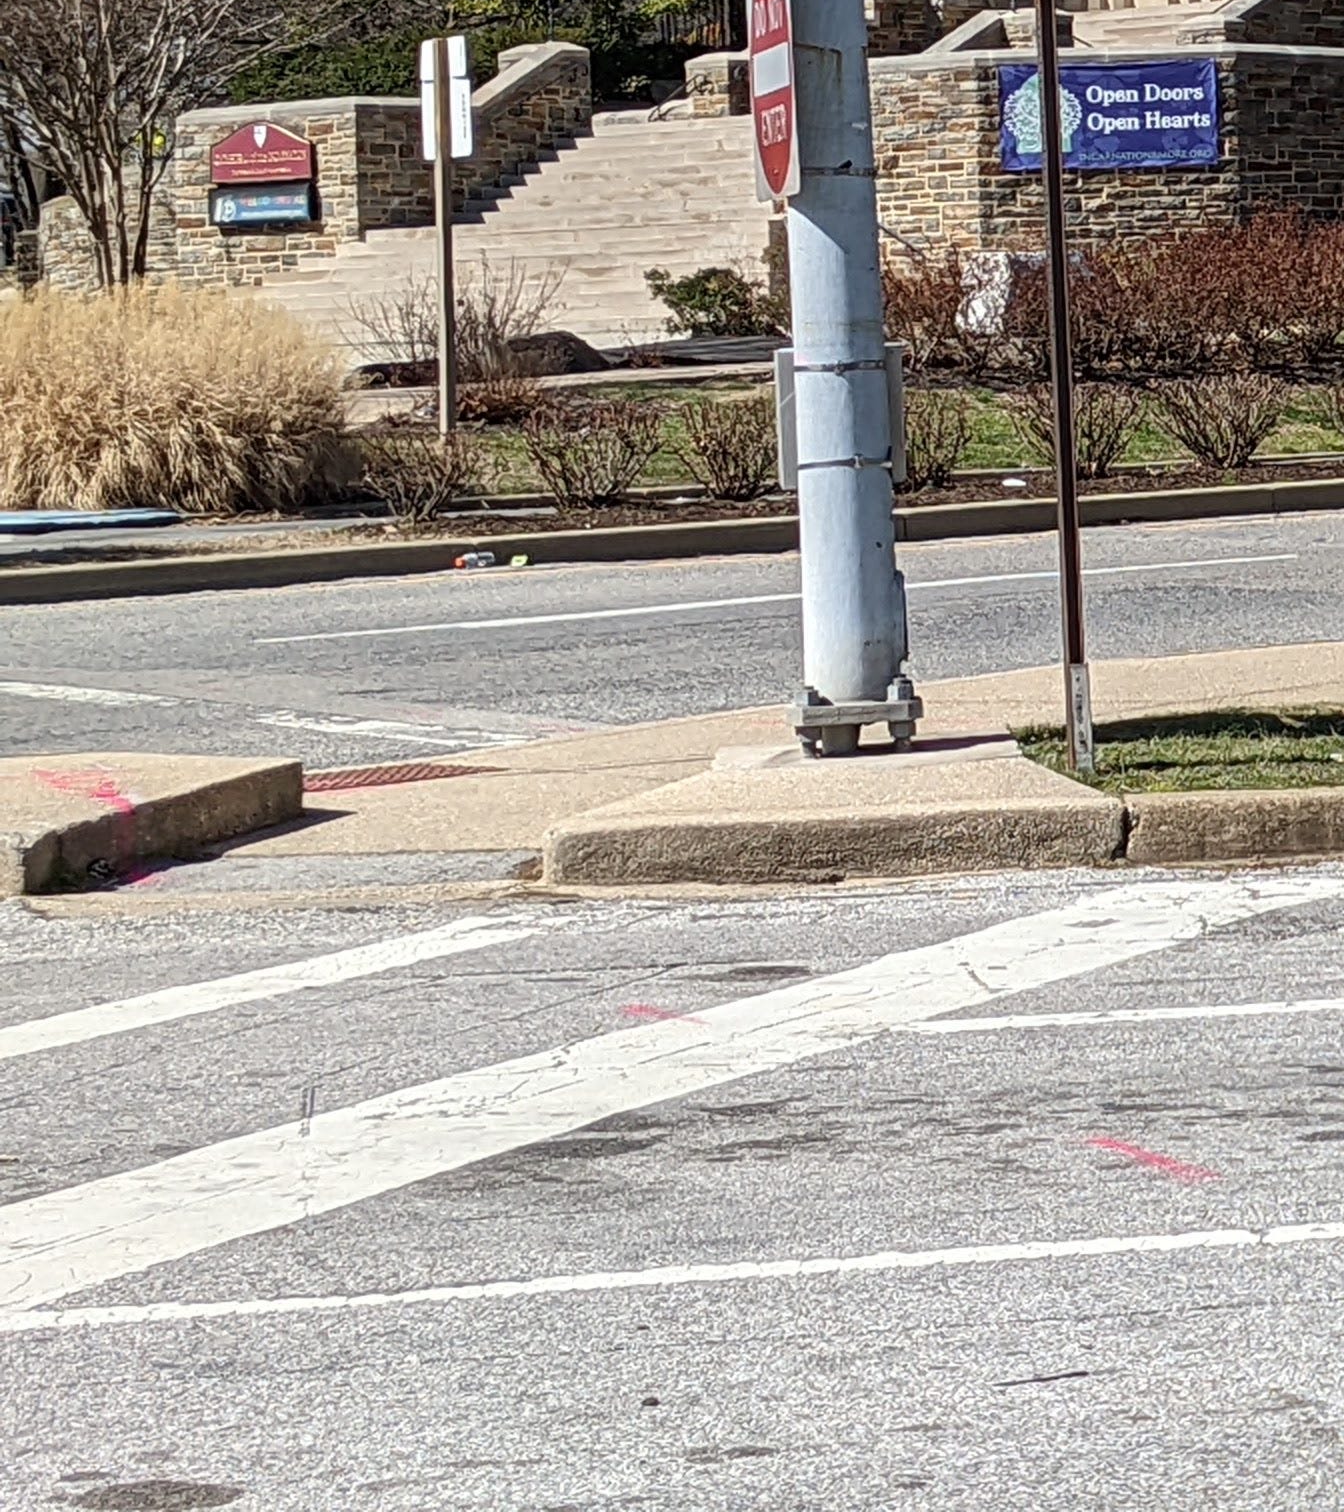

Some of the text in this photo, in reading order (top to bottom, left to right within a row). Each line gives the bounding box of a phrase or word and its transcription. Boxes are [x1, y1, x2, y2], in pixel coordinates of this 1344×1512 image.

[754, 0, 766, 38] DO
[1085, 83, 1205, 107] Open Doors
[761, 103, 787, 147] ENTER
[1087, 110, 1211, 135] Open Hearts
